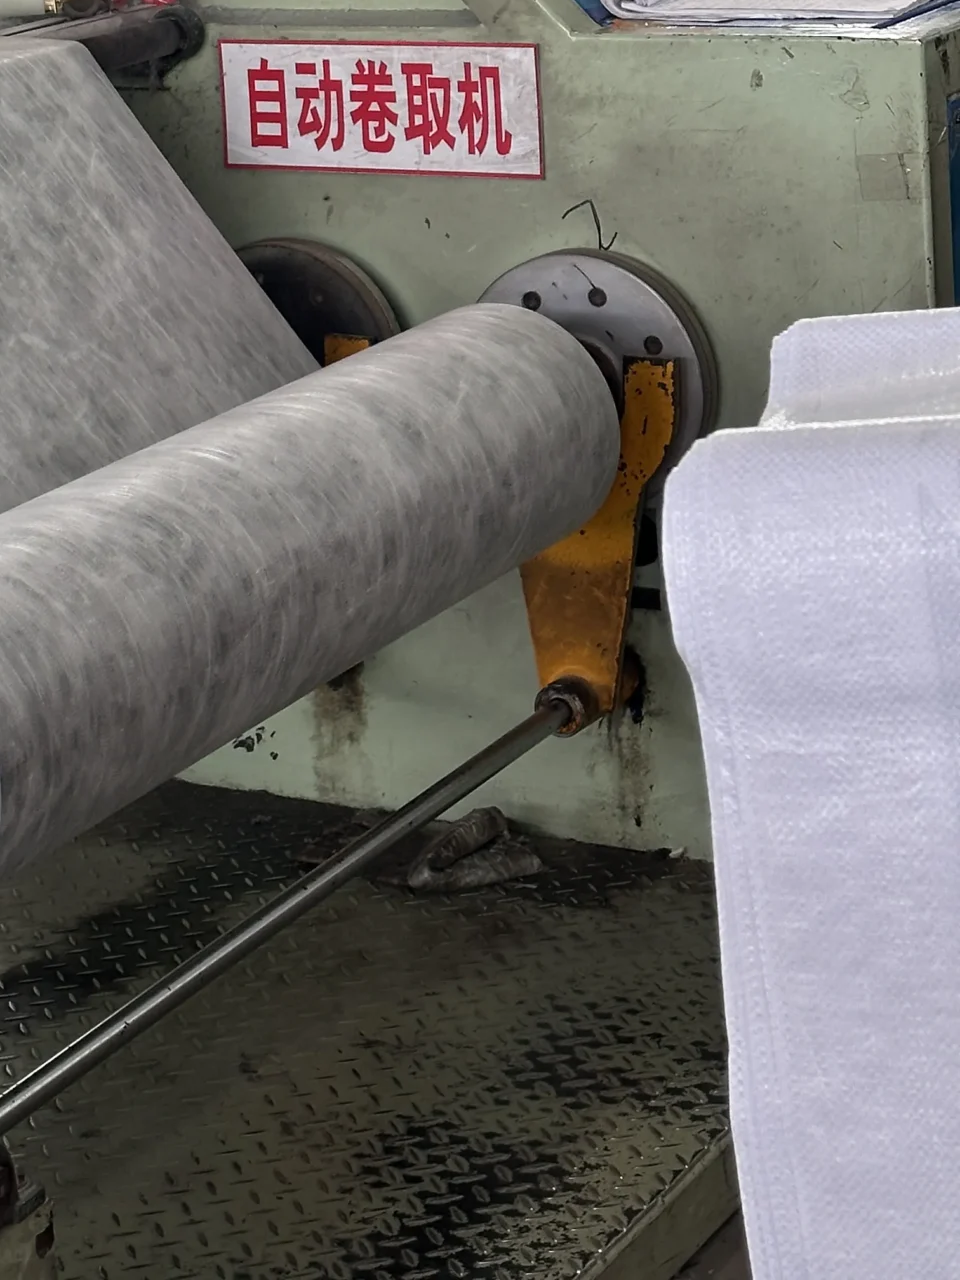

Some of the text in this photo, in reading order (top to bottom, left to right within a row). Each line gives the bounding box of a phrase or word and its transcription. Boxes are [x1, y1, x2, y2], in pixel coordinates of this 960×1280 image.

[247, 57, 513, 156] 自动卷取机
